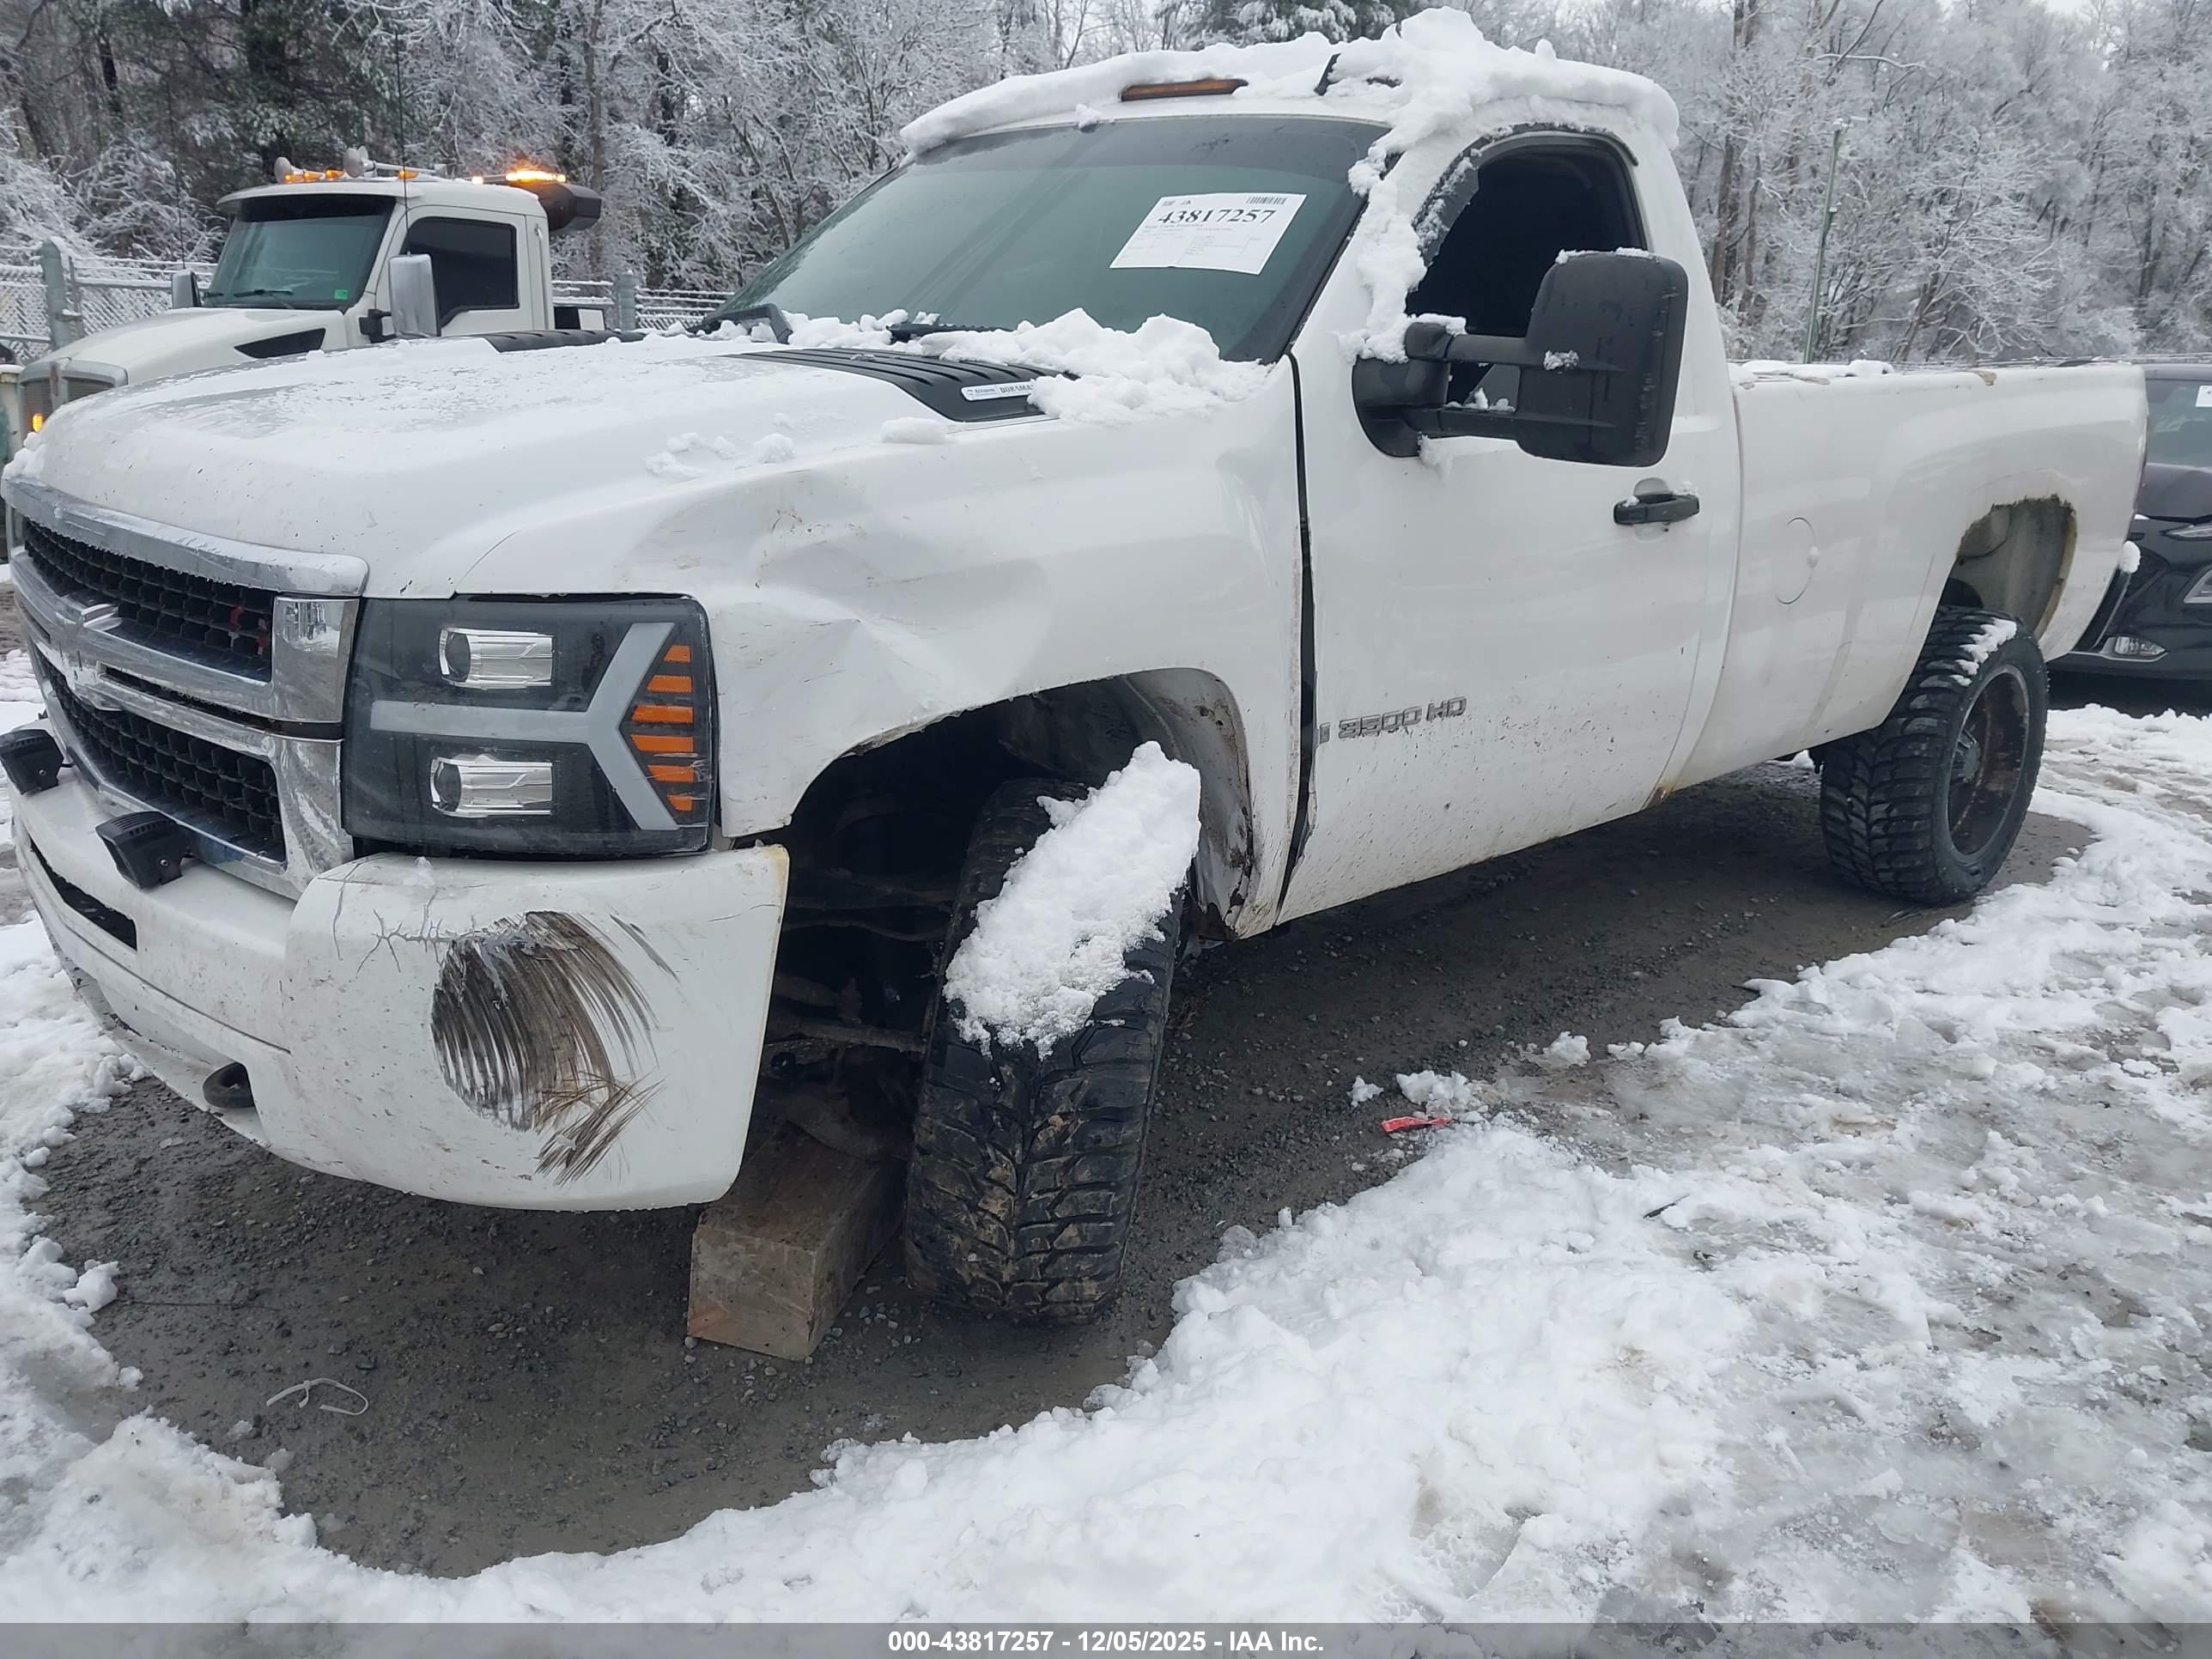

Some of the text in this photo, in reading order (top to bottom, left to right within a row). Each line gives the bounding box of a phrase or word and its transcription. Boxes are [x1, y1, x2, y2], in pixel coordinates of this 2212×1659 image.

[1158, 209, 1277, 223] 43817257
[1338, 696, 1468, 739] 3500 HD
